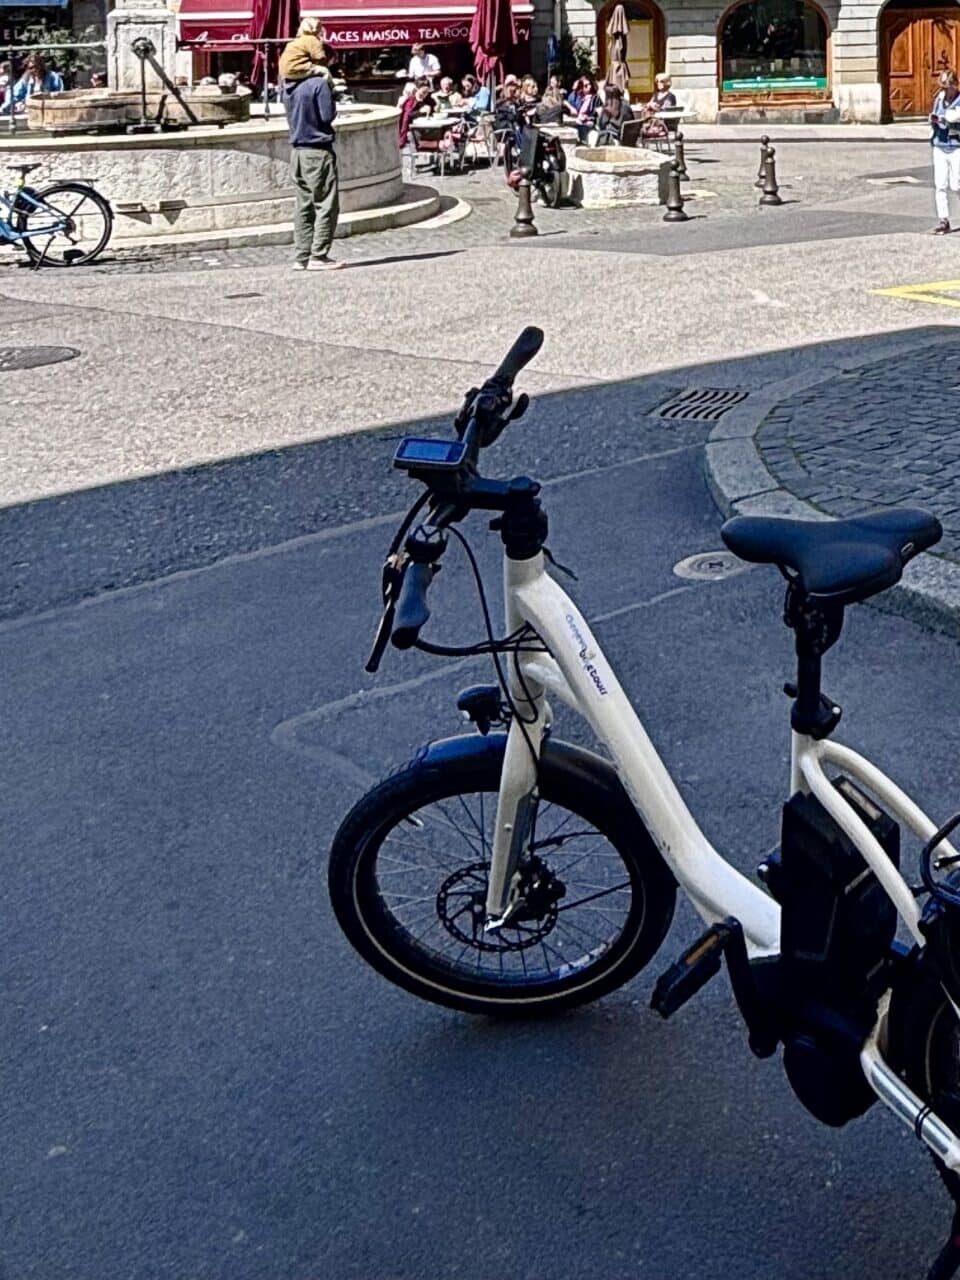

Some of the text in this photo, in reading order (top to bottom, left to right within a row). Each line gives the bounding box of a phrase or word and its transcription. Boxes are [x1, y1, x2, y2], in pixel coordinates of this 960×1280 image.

[322, 27, 469, 43] LACES MAISON TEA-ROO
